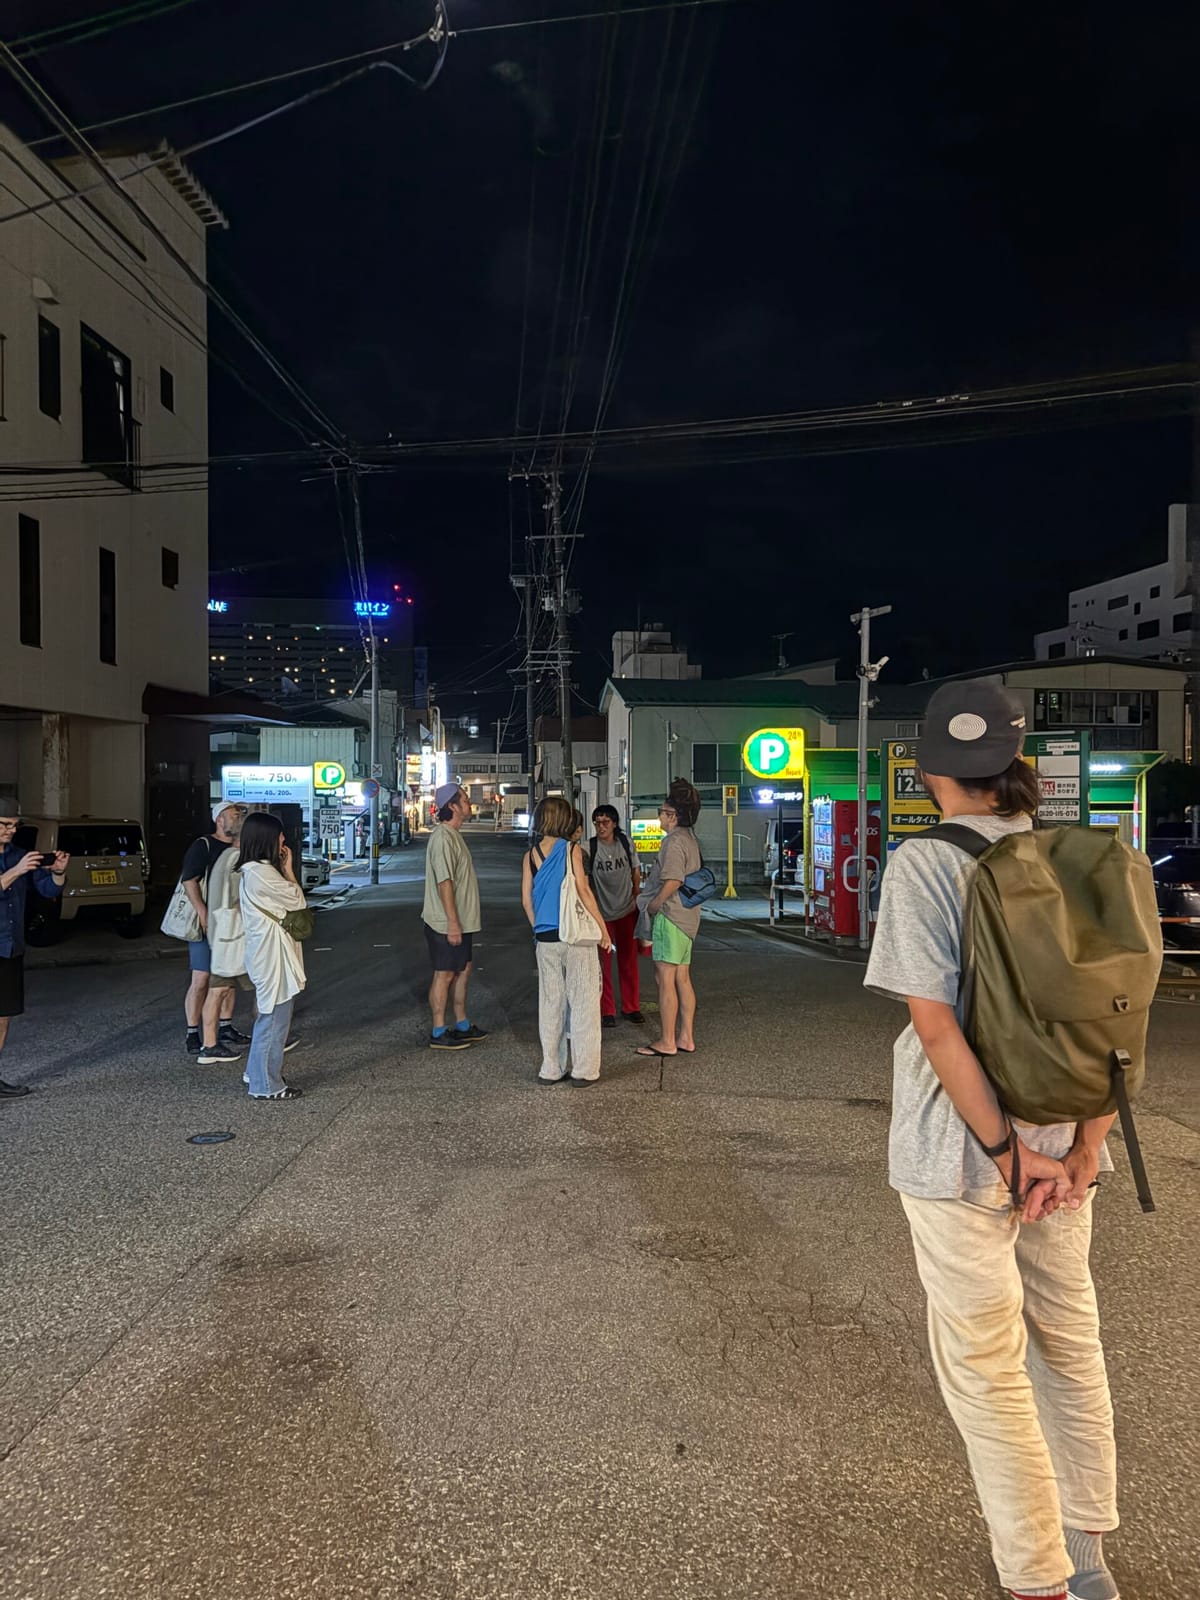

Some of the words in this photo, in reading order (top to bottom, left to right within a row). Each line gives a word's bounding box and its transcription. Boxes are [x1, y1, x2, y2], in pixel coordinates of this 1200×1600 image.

[760, 739, 785, 770] P
[895, 746, 904, 757] P
[325, 767, 340, 784] P
[895, 816, 937, 824] オールタイム
[321, 825, 339, 834] 750
